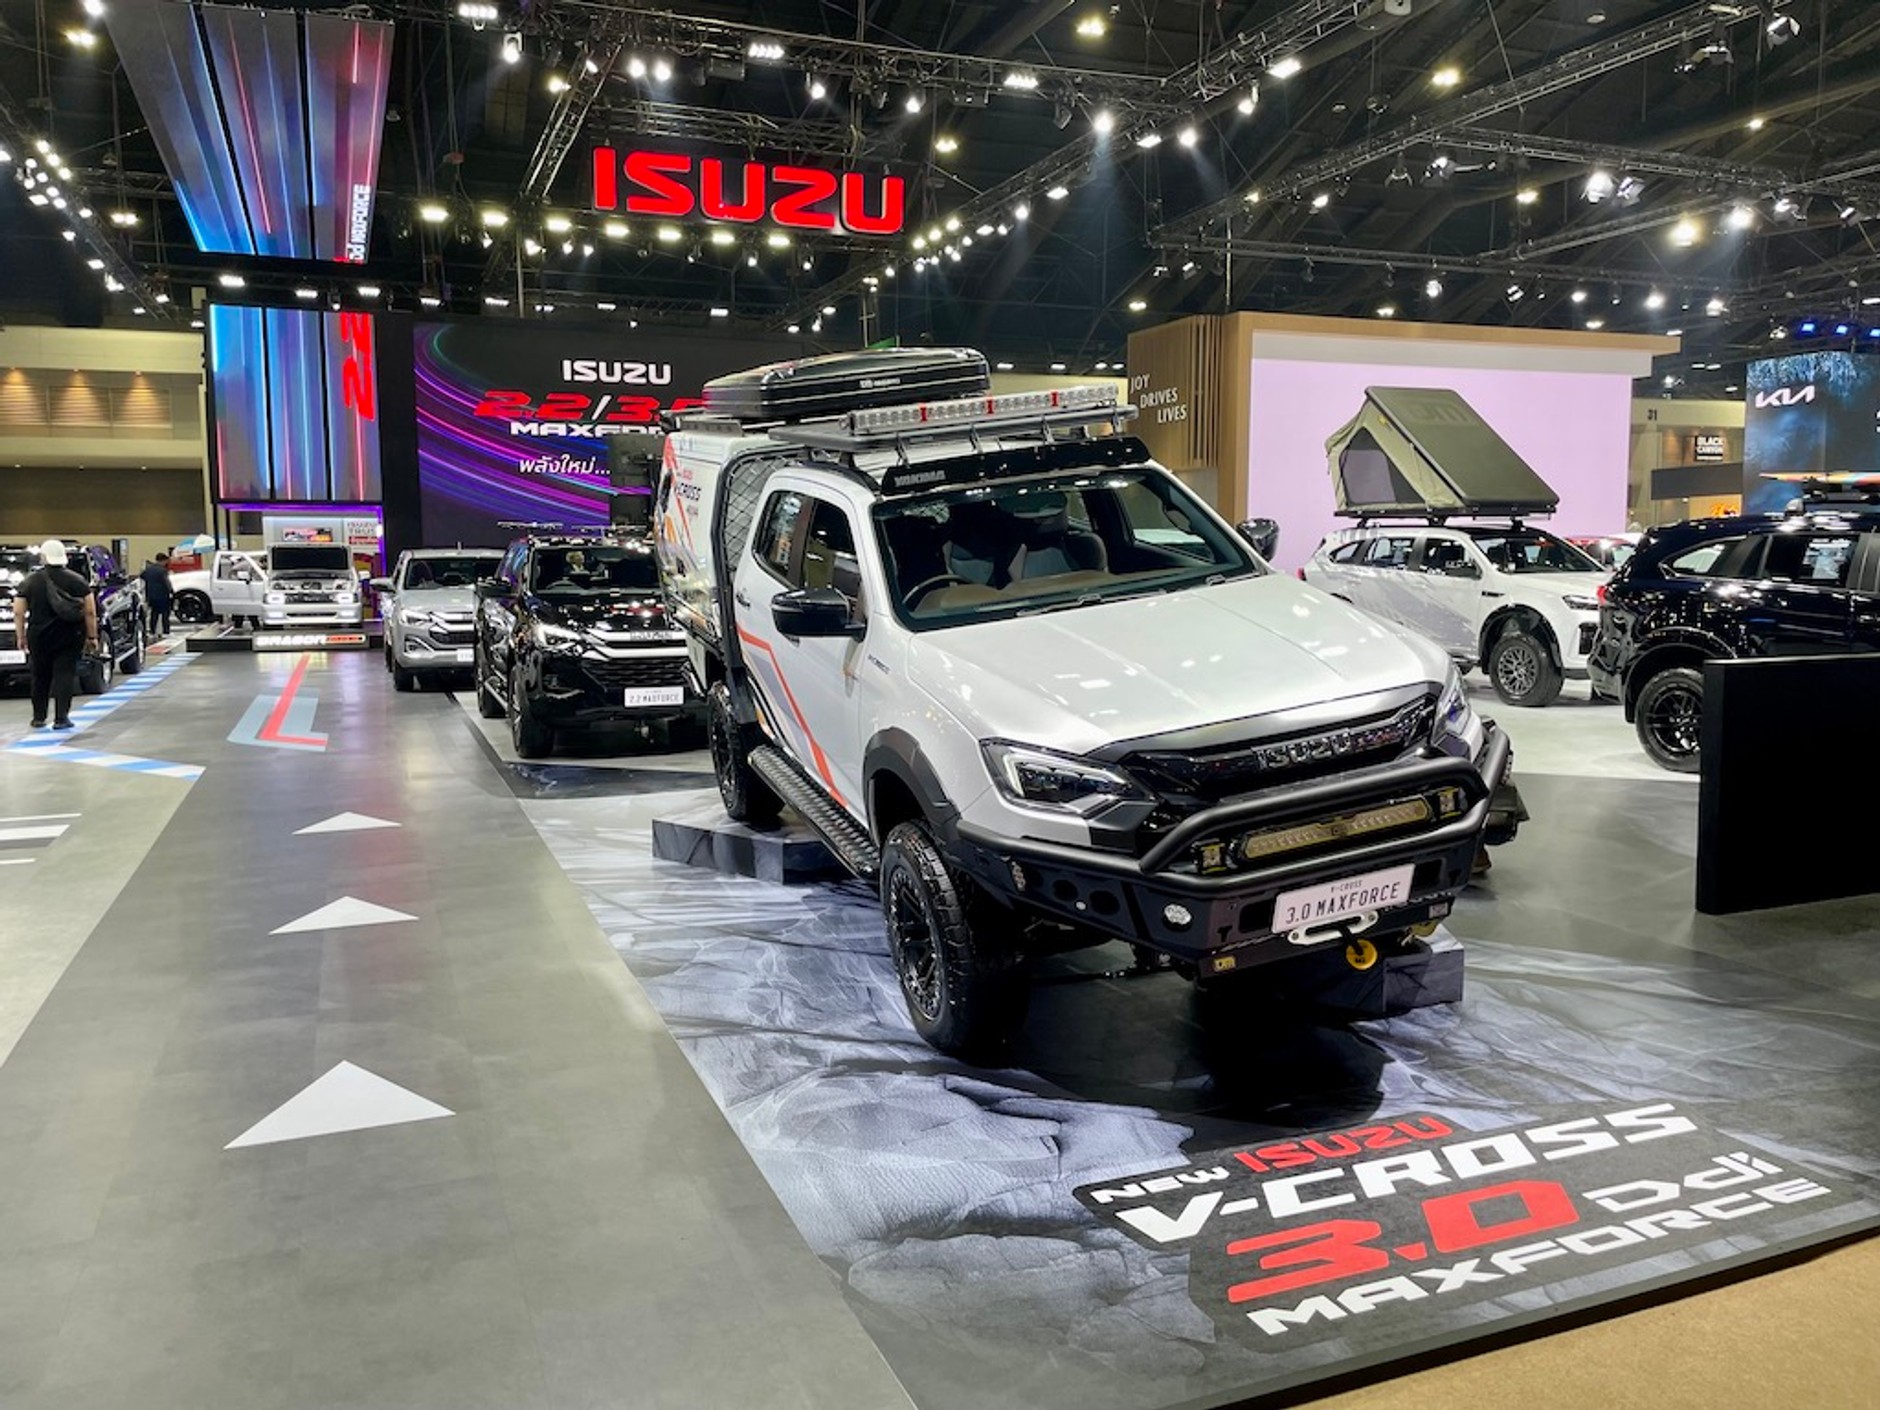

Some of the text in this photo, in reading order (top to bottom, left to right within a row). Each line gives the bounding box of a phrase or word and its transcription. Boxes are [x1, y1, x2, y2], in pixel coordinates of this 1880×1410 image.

[593, 146, 906, 235] ISUZU
[561, 359, 672, 385] ISUZU
[1130, 374, 1151, 394] JOY
[1140, 387, 1178, 409] DRIVES
[1158, 404, 1187, 424] LIVES
[1252, 729, 1350, 769] ISUZU
[1286, 881, 1400, 924] 3.0 MAXFORCE
[1090, 1116, 1454, 1204] NEW ISUZU
[1115, 1103, 1698, 1243] V-CROSS
[1226, 1179, 1580, 1303] 3.0
[1246, 1177, 1832, 1336] MAXFORCE
